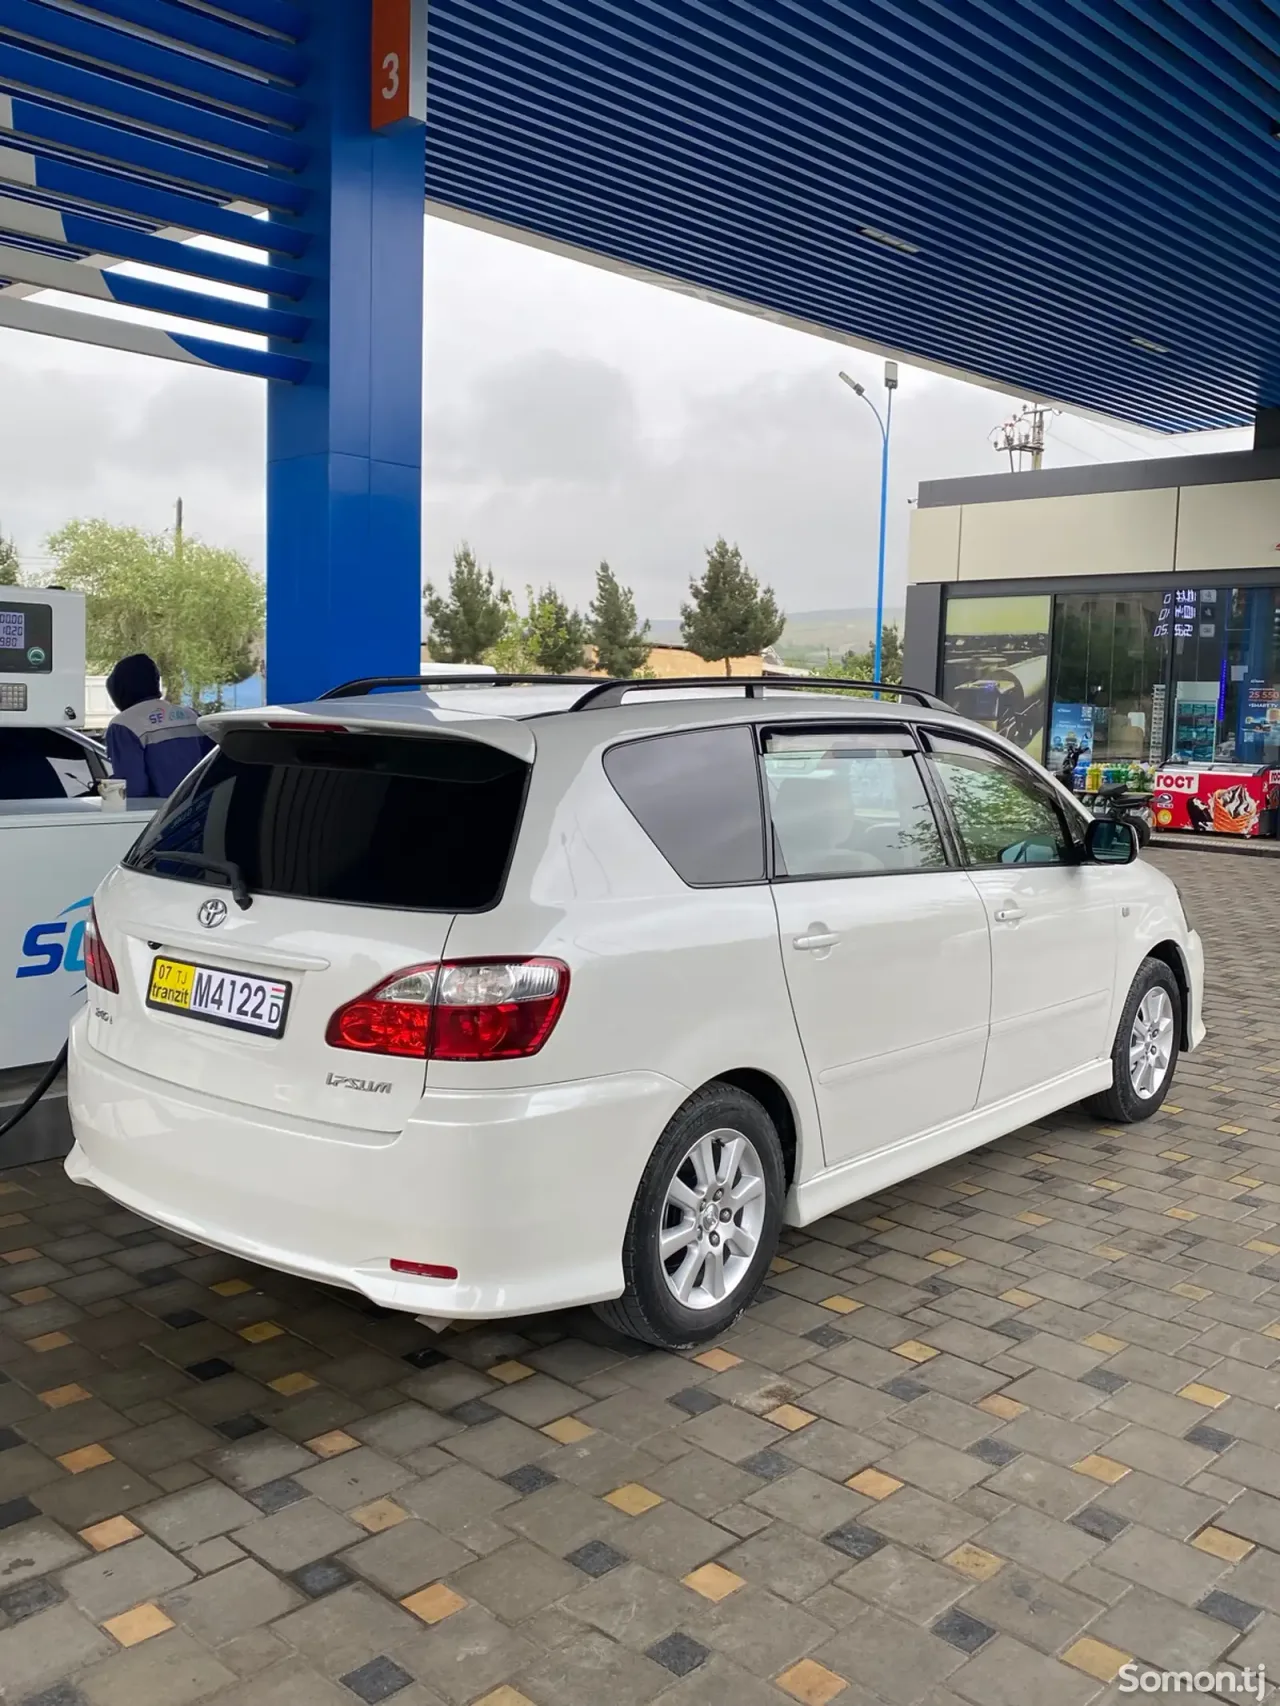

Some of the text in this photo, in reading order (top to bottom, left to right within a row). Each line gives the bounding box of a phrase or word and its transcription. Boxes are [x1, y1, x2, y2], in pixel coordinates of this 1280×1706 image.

[382, 52, 399, 99] 3
[1156, 775, 1194, 789] ГОСТ
[158, 964, 188, 984] 07 TJ
[152, 982, 189, 1004] tranzit
[193, 973, 281, 1023] M4122 D
